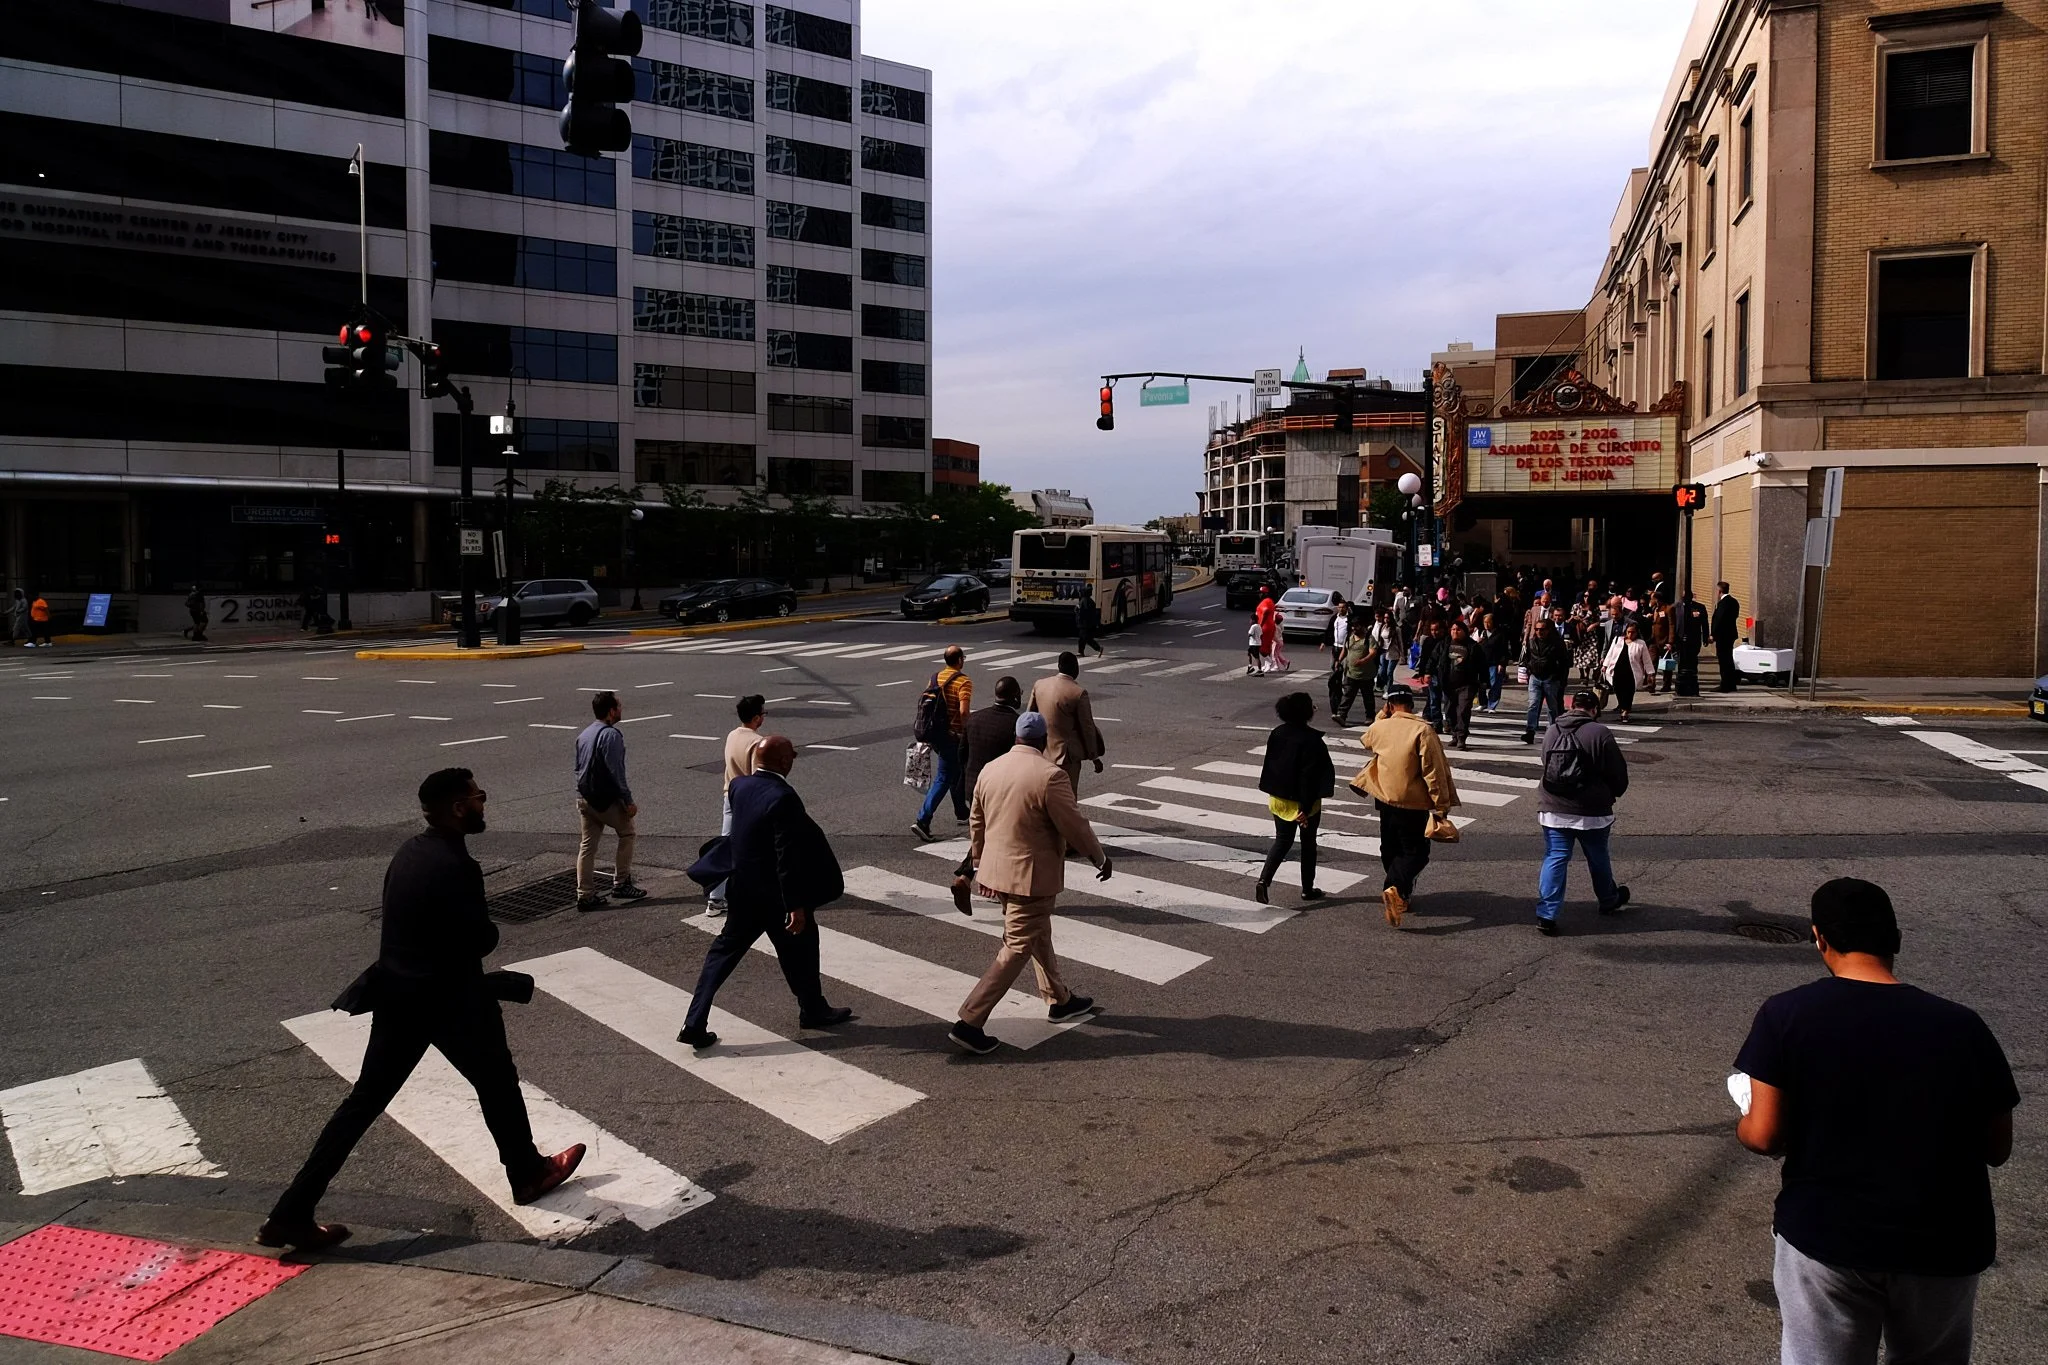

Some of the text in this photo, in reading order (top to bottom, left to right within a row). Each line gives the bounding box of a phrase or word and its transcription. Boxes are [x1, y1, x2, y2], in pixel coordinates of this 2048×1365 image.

[24, 204, 122, 223] OUTPATIENT
[130, 215, 188, 231] CENTER
[195, 222, 212, 233] AT
[219, 225, 272, 241] JERSEY
[277, 231, 309, 245] CITY
[32, 221, 110, 240] HOSPITAL
[117, 230, 185, 247] IMAGING
[192, 237, 225, 251] AND
[230, 242, 337, 263] THERAPEUTICS
[1144, 391, 1174, 402] Pavonia
[1473, 431, 1486, 439] JW
[1531, 430, 1565, 441] 2025
[1581, 428, 1618, 440] 2026
[1488, 440, 1661, 455] ASAMBLEA DE CIRCUITO
[1516, 455, 1634, 469] DE LOS TESTIGOS
[1531, 469, 1615, 482] DE JEHOVA
[1689, 490, 1696, 503] 2
[243, 508, 317, 517] URGENT CARE
[221, 599, 304, 623] 2 JOURNA
[247, 611, 302, 622] SQUARE
